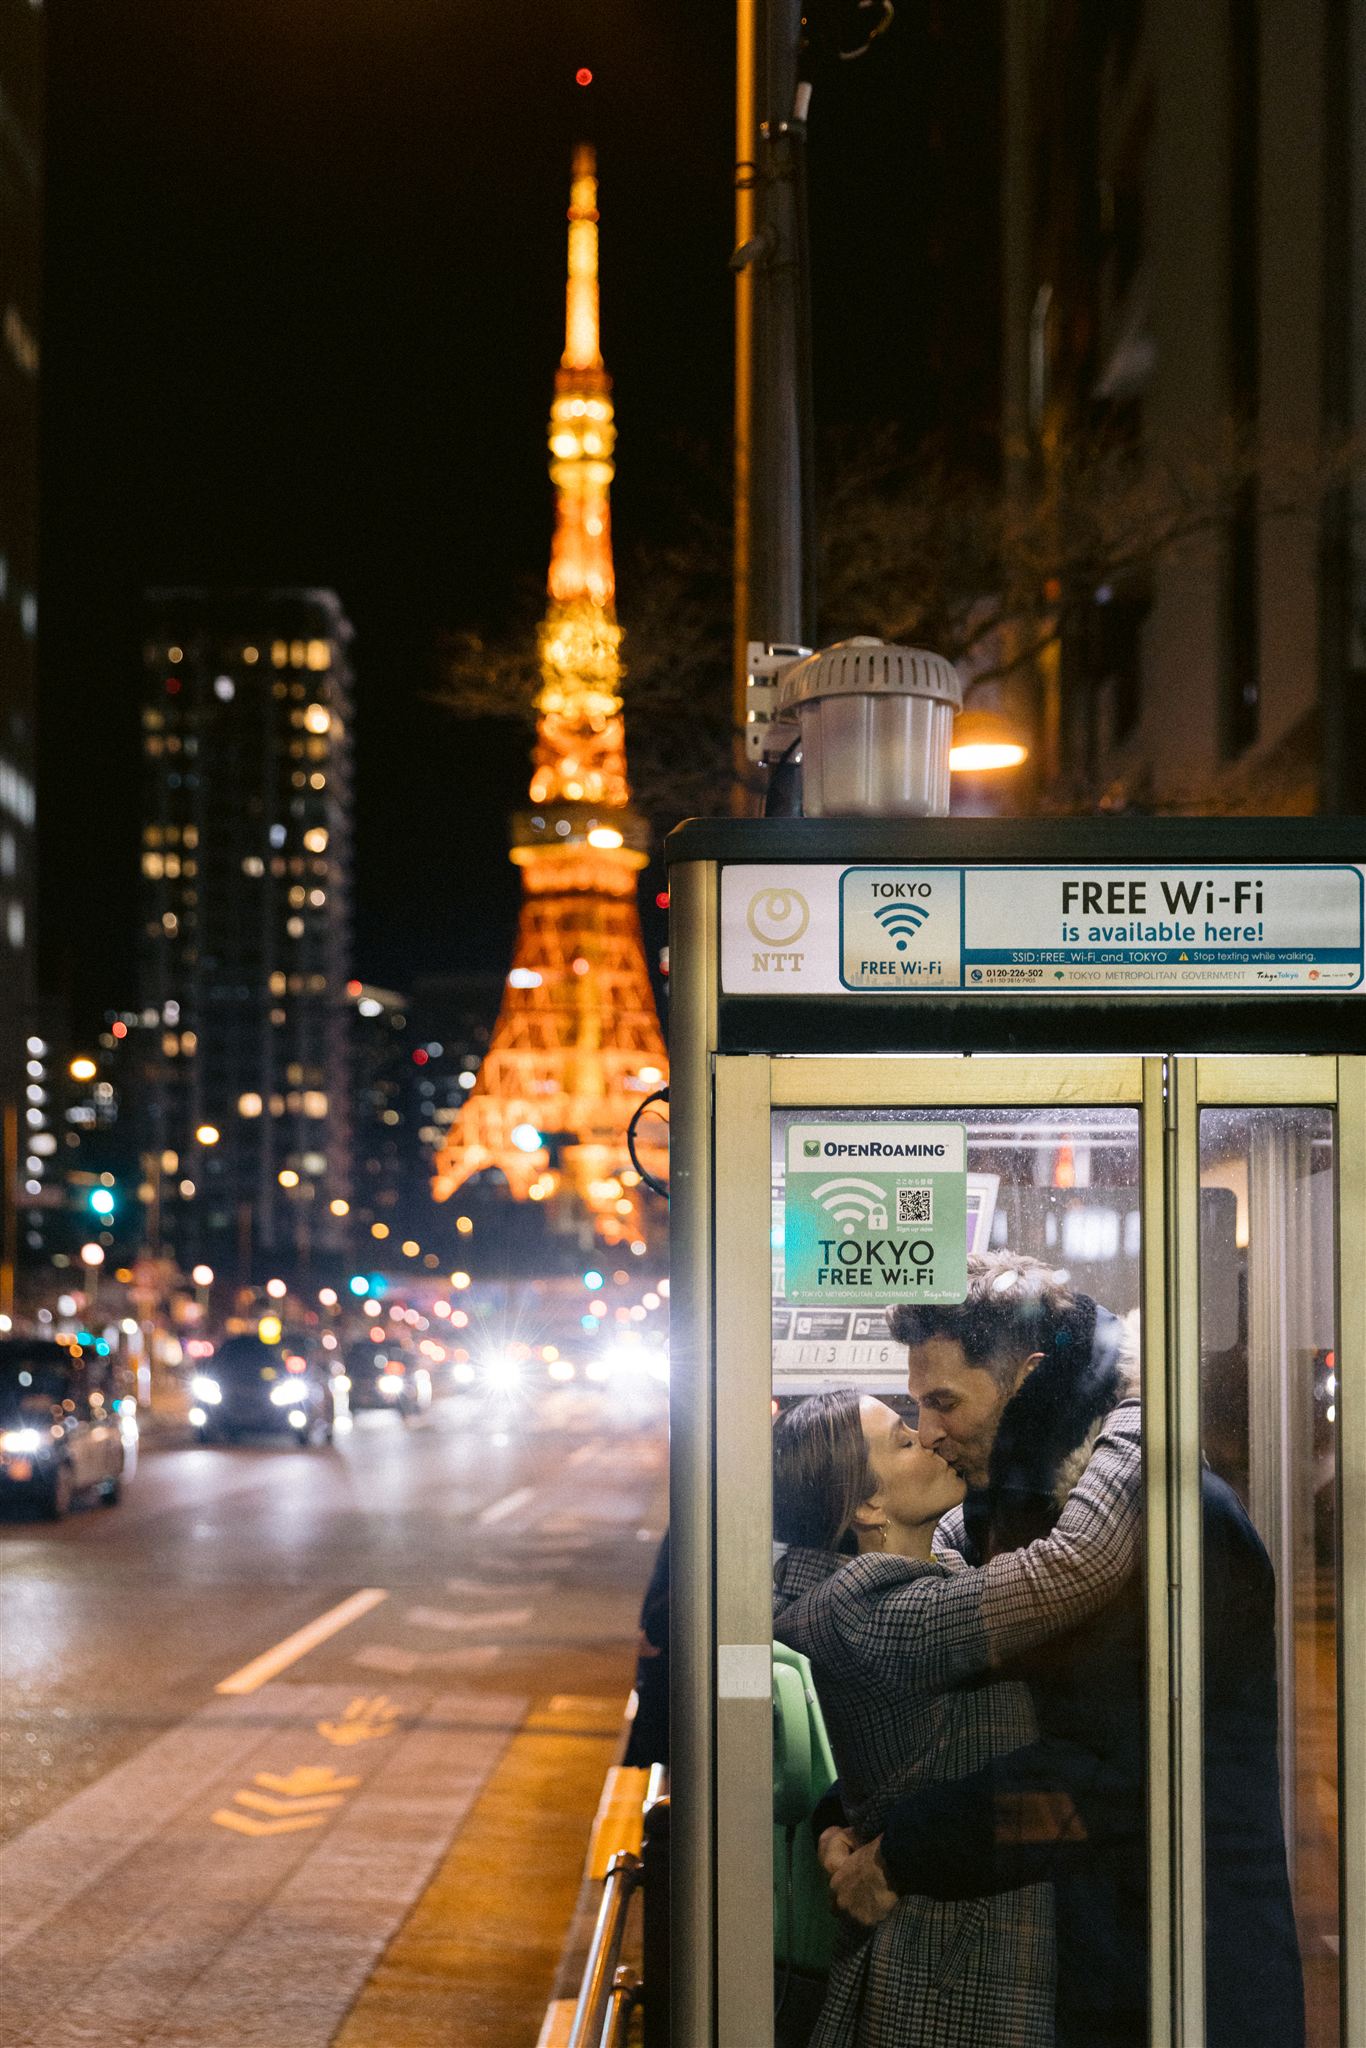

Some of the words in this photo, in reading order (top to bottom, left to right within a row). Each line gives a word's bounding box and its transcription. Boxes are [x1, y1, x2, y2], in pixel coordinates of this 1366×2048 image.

[871, 883, 932, 898] TOKYO
[1062, 882, 1146, 913] FREE
[1161, 880, 1264, 913] Wi-Fi
[1062, 922, 1080, 942] is
[1088, 922, 1195, 942] available
[1204, 922, 1264, 942] here!
[752, 953, 804, 972] NTT
[1193, 951, 1215, 962] Stop
[1218, 951, 1249, 962] texting
[1252, 951, 1276, 961] while
[1278, 951, 1317, 962] walking.
[861, 961, 895, 975] FREE
[901, 961, 942, 975] Wi-Fi
[986, 969, 1043, 978] 0120-226-502
[1069, 971, 1100, 980] TOKYO
[1105, 971, 1177, 980] METROPOLITAN
[1181, 971, 1246, 980] GOVERNMENT
[818, 1240, 934, 1265] TOKYO
[818, 1268, 872, 1285] FREE
[881, 1268, 934, 1285] Wi-Fi
